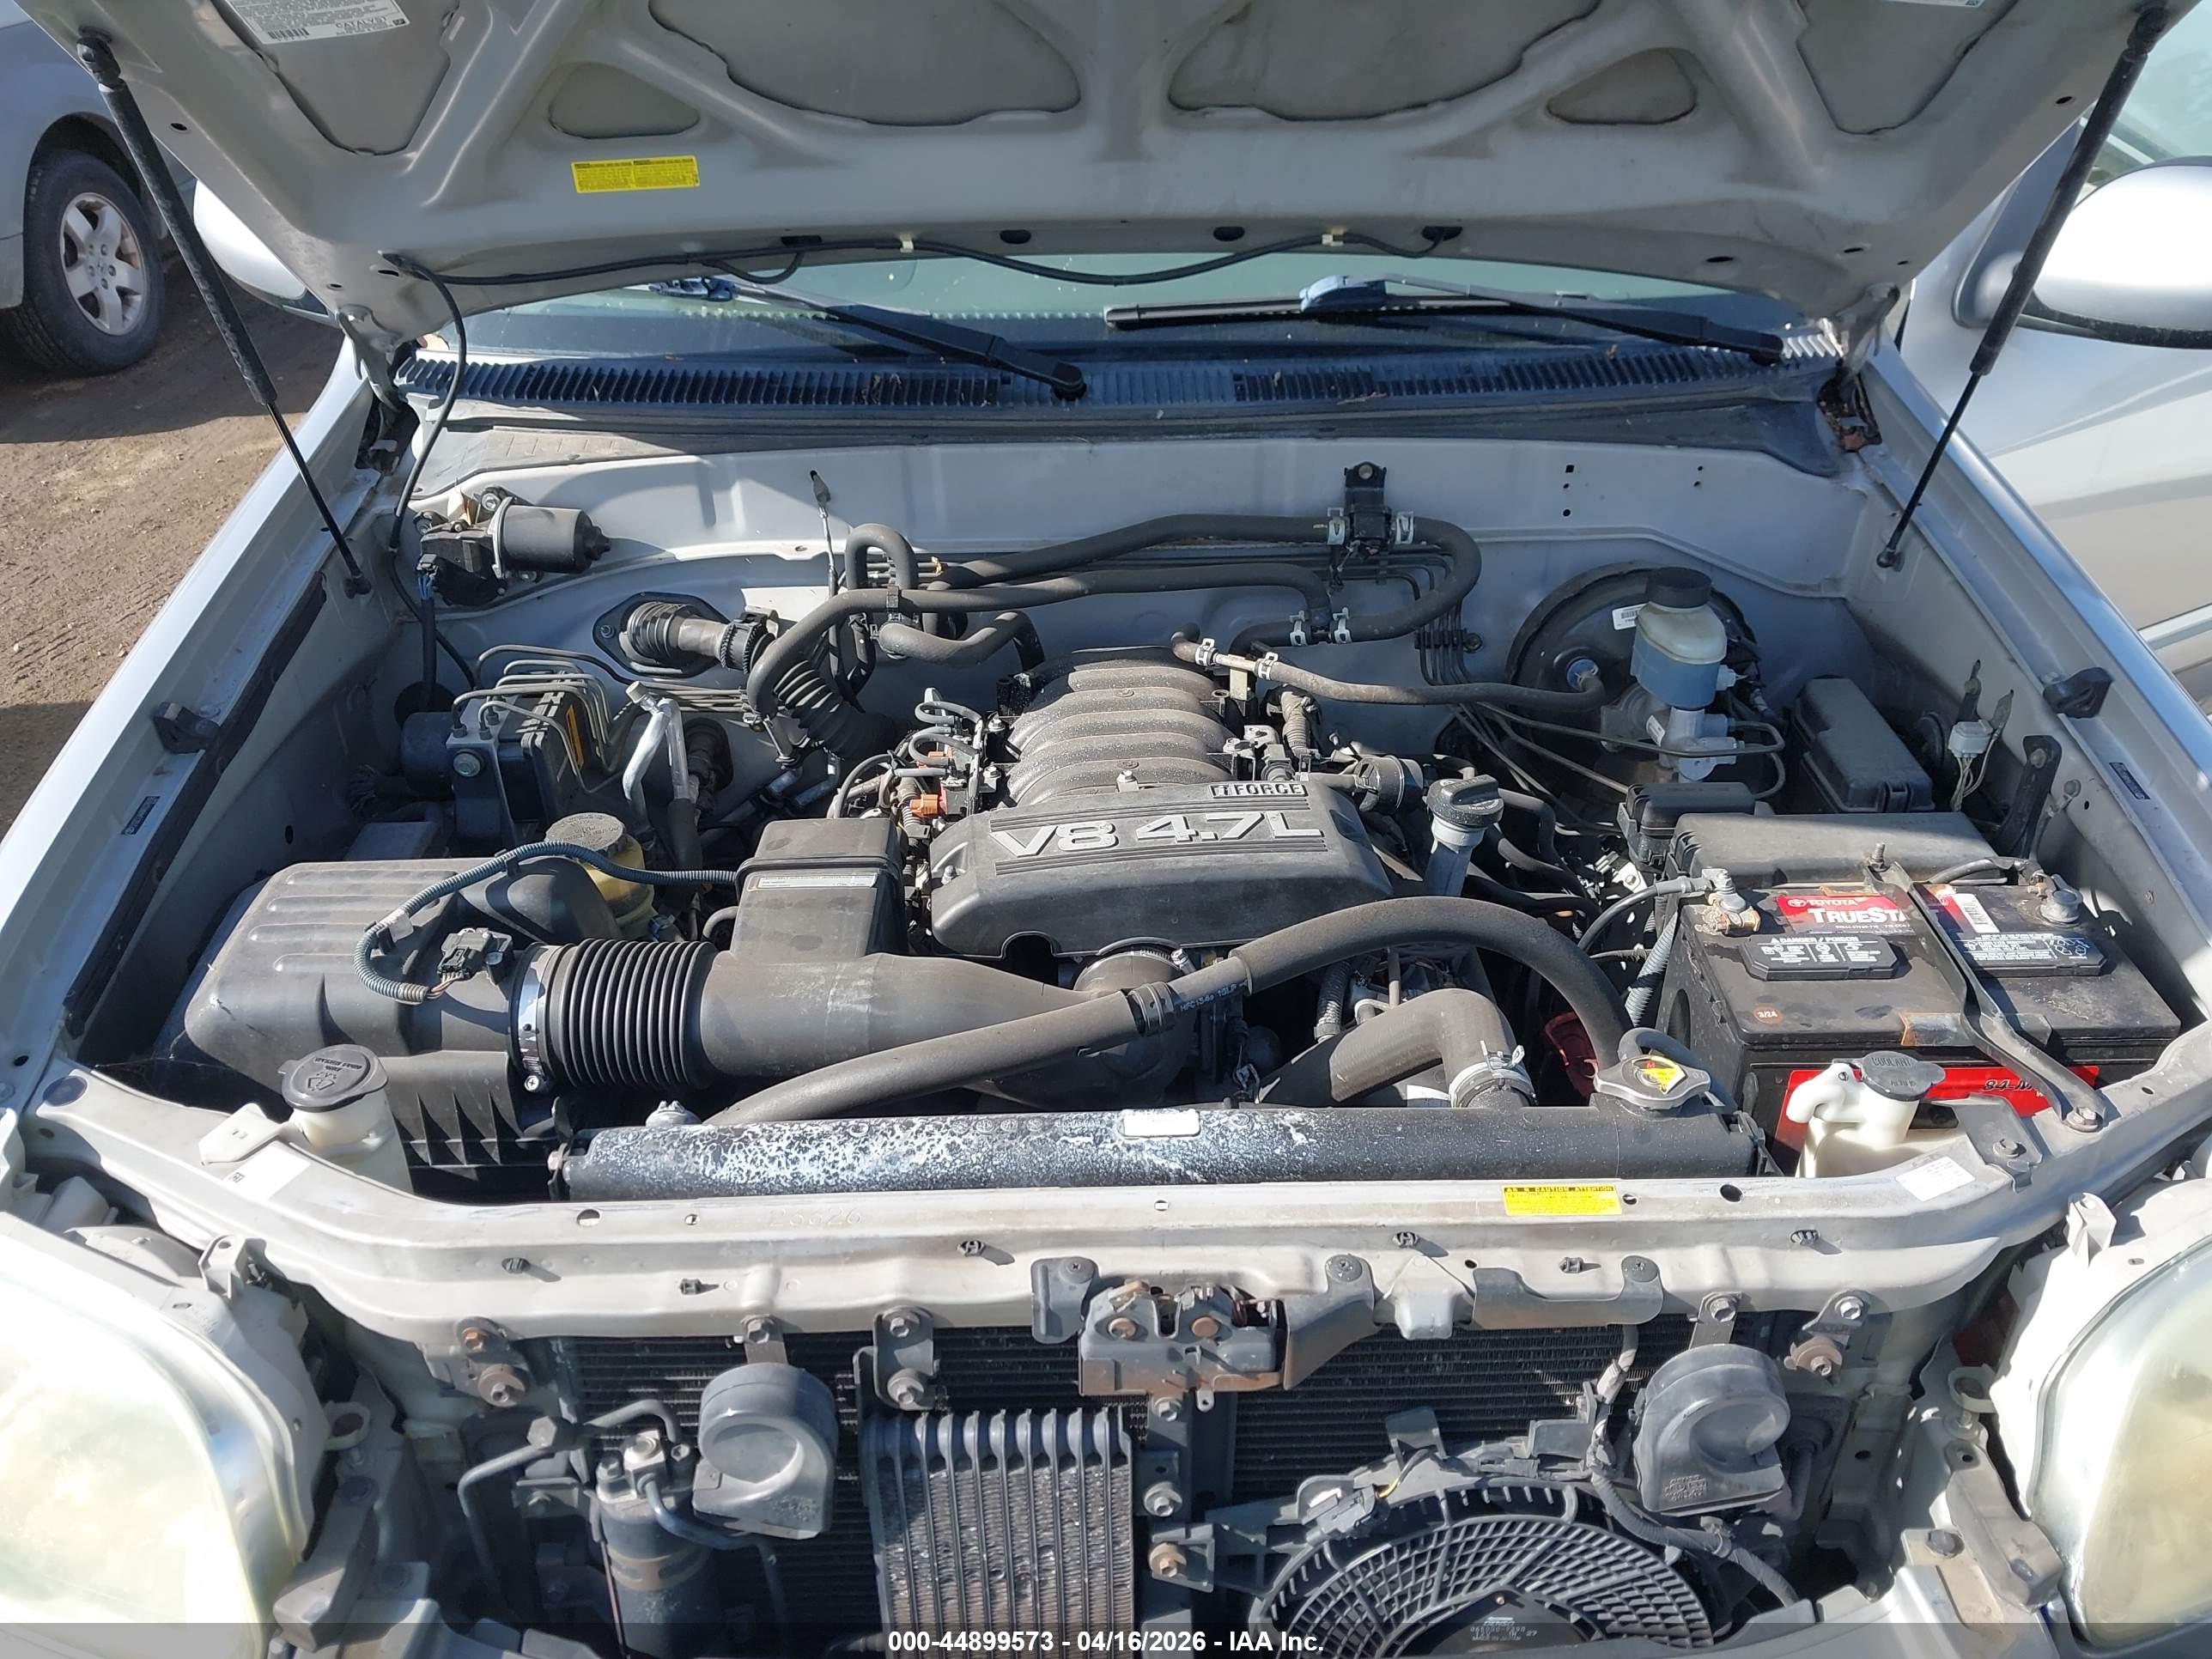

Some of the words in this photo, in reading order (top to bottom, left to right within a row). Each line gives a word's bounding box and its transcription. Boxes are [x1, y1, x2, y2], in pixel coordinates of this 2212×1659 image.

[989, 821, 1118, 858] V8
[1135, 811, 1325, 843] 4.7L
[1872, 1057, 1911, 1066] COOLANT
